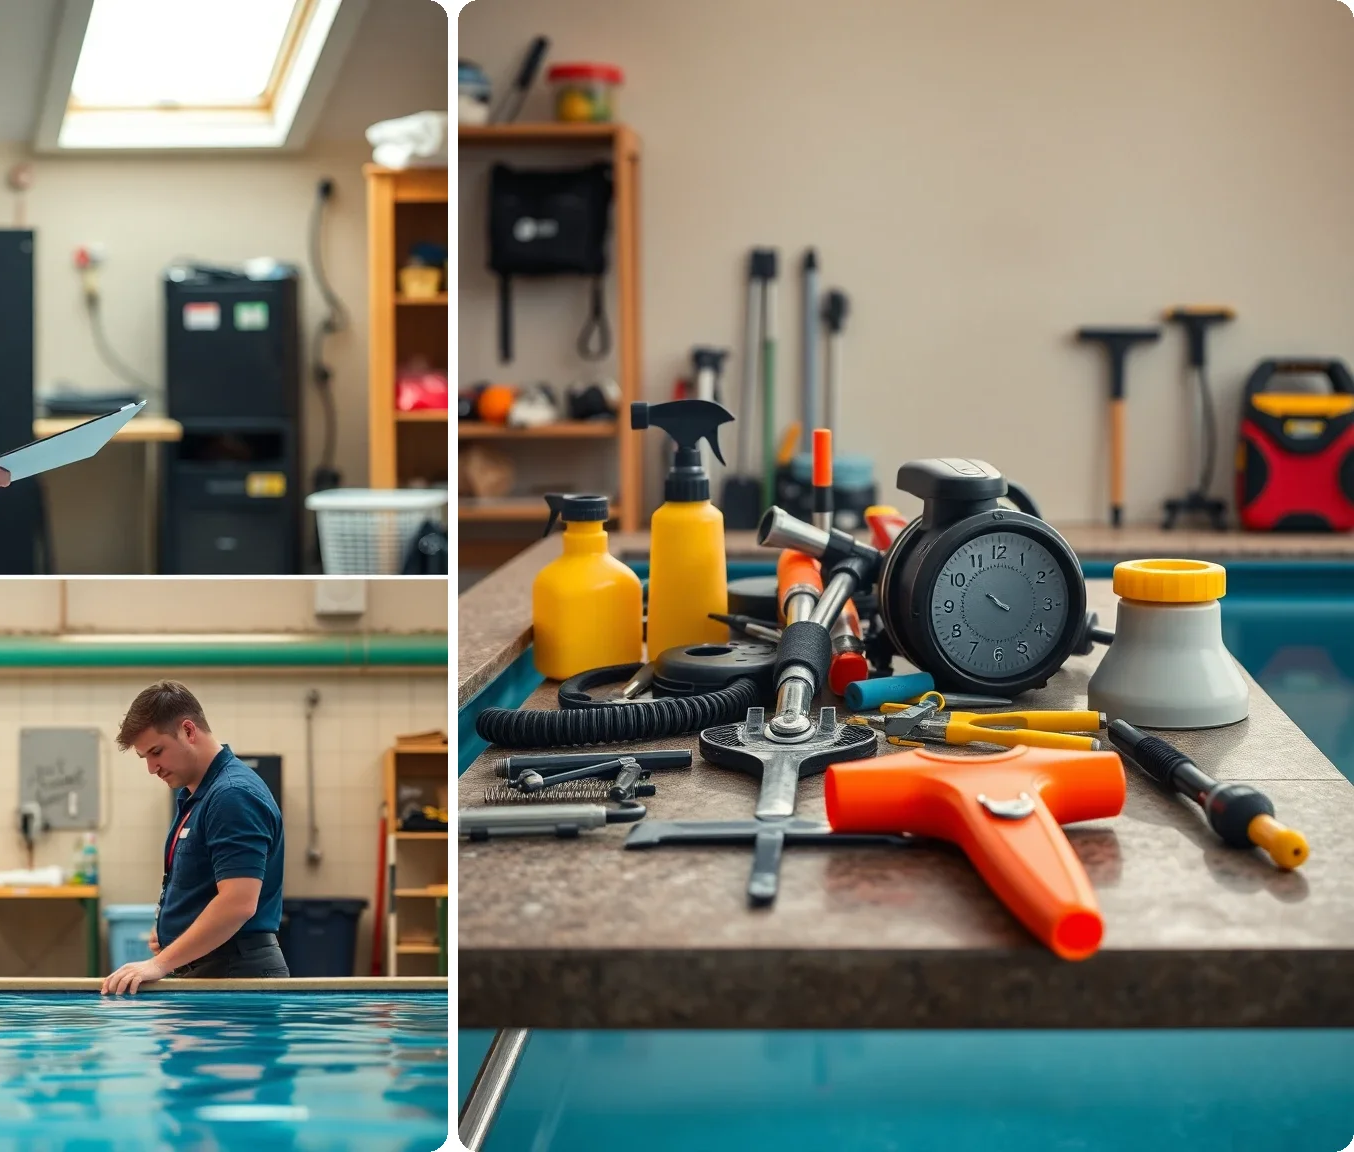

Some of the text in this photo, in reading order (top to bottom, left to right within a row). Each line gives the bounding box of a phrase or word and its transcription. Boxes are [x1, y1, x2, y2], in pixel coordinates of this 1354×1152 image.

[992, 545, 1007, 560] 12
[970, 554, 983, 568] 11
[950, 573, 965, 587] 10
[1036, 571, 1046, 584] 2
[944, 600, 954, 613] 9
[1043, 597, 1053, 611] 3
[951, 624, 961, 638] 8
[1034, 622, 1044, 636] 4
[969, 641, 979, 655] 7
[1017, 640, 1029, 653] 5
[993, 647, 1004, 662] 6
